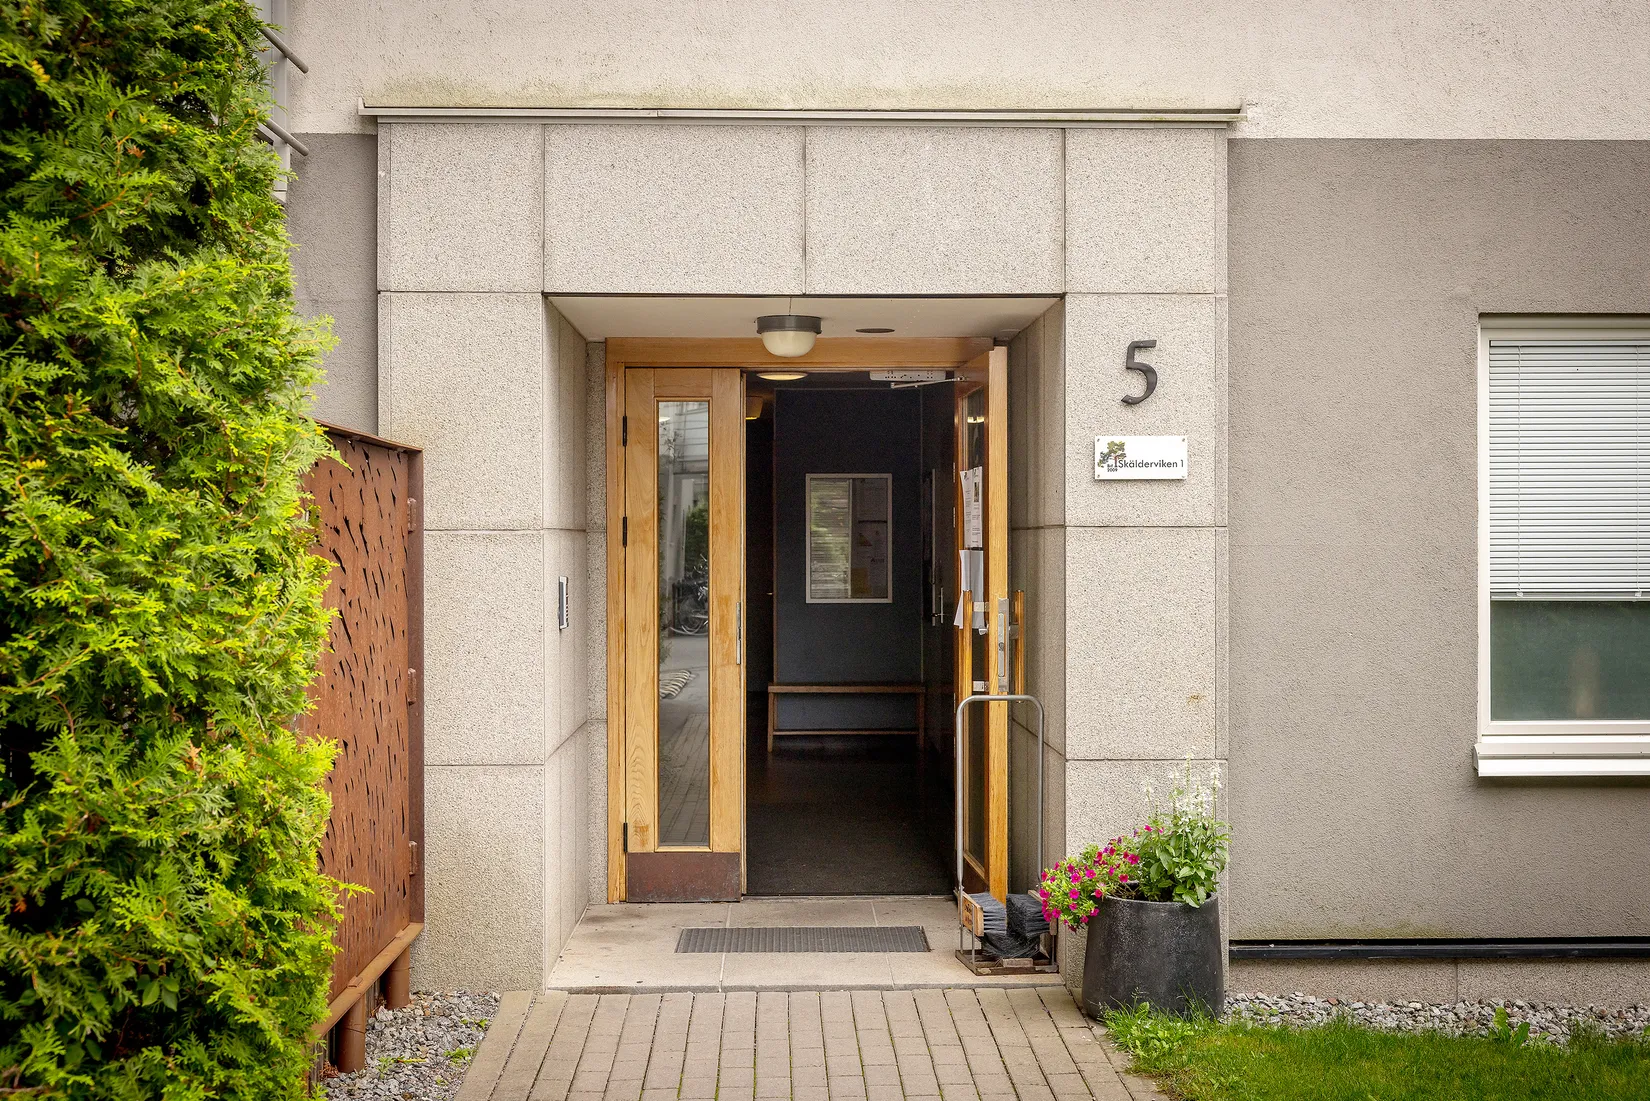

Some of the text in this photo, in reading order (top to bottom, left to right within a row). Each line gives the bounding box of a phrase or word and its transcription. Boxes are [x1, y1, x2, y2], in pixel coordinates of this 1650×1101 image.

[1121, 340, 1157, 404] 5
[1118, 460, 1184, 468] Skälderviken 1
